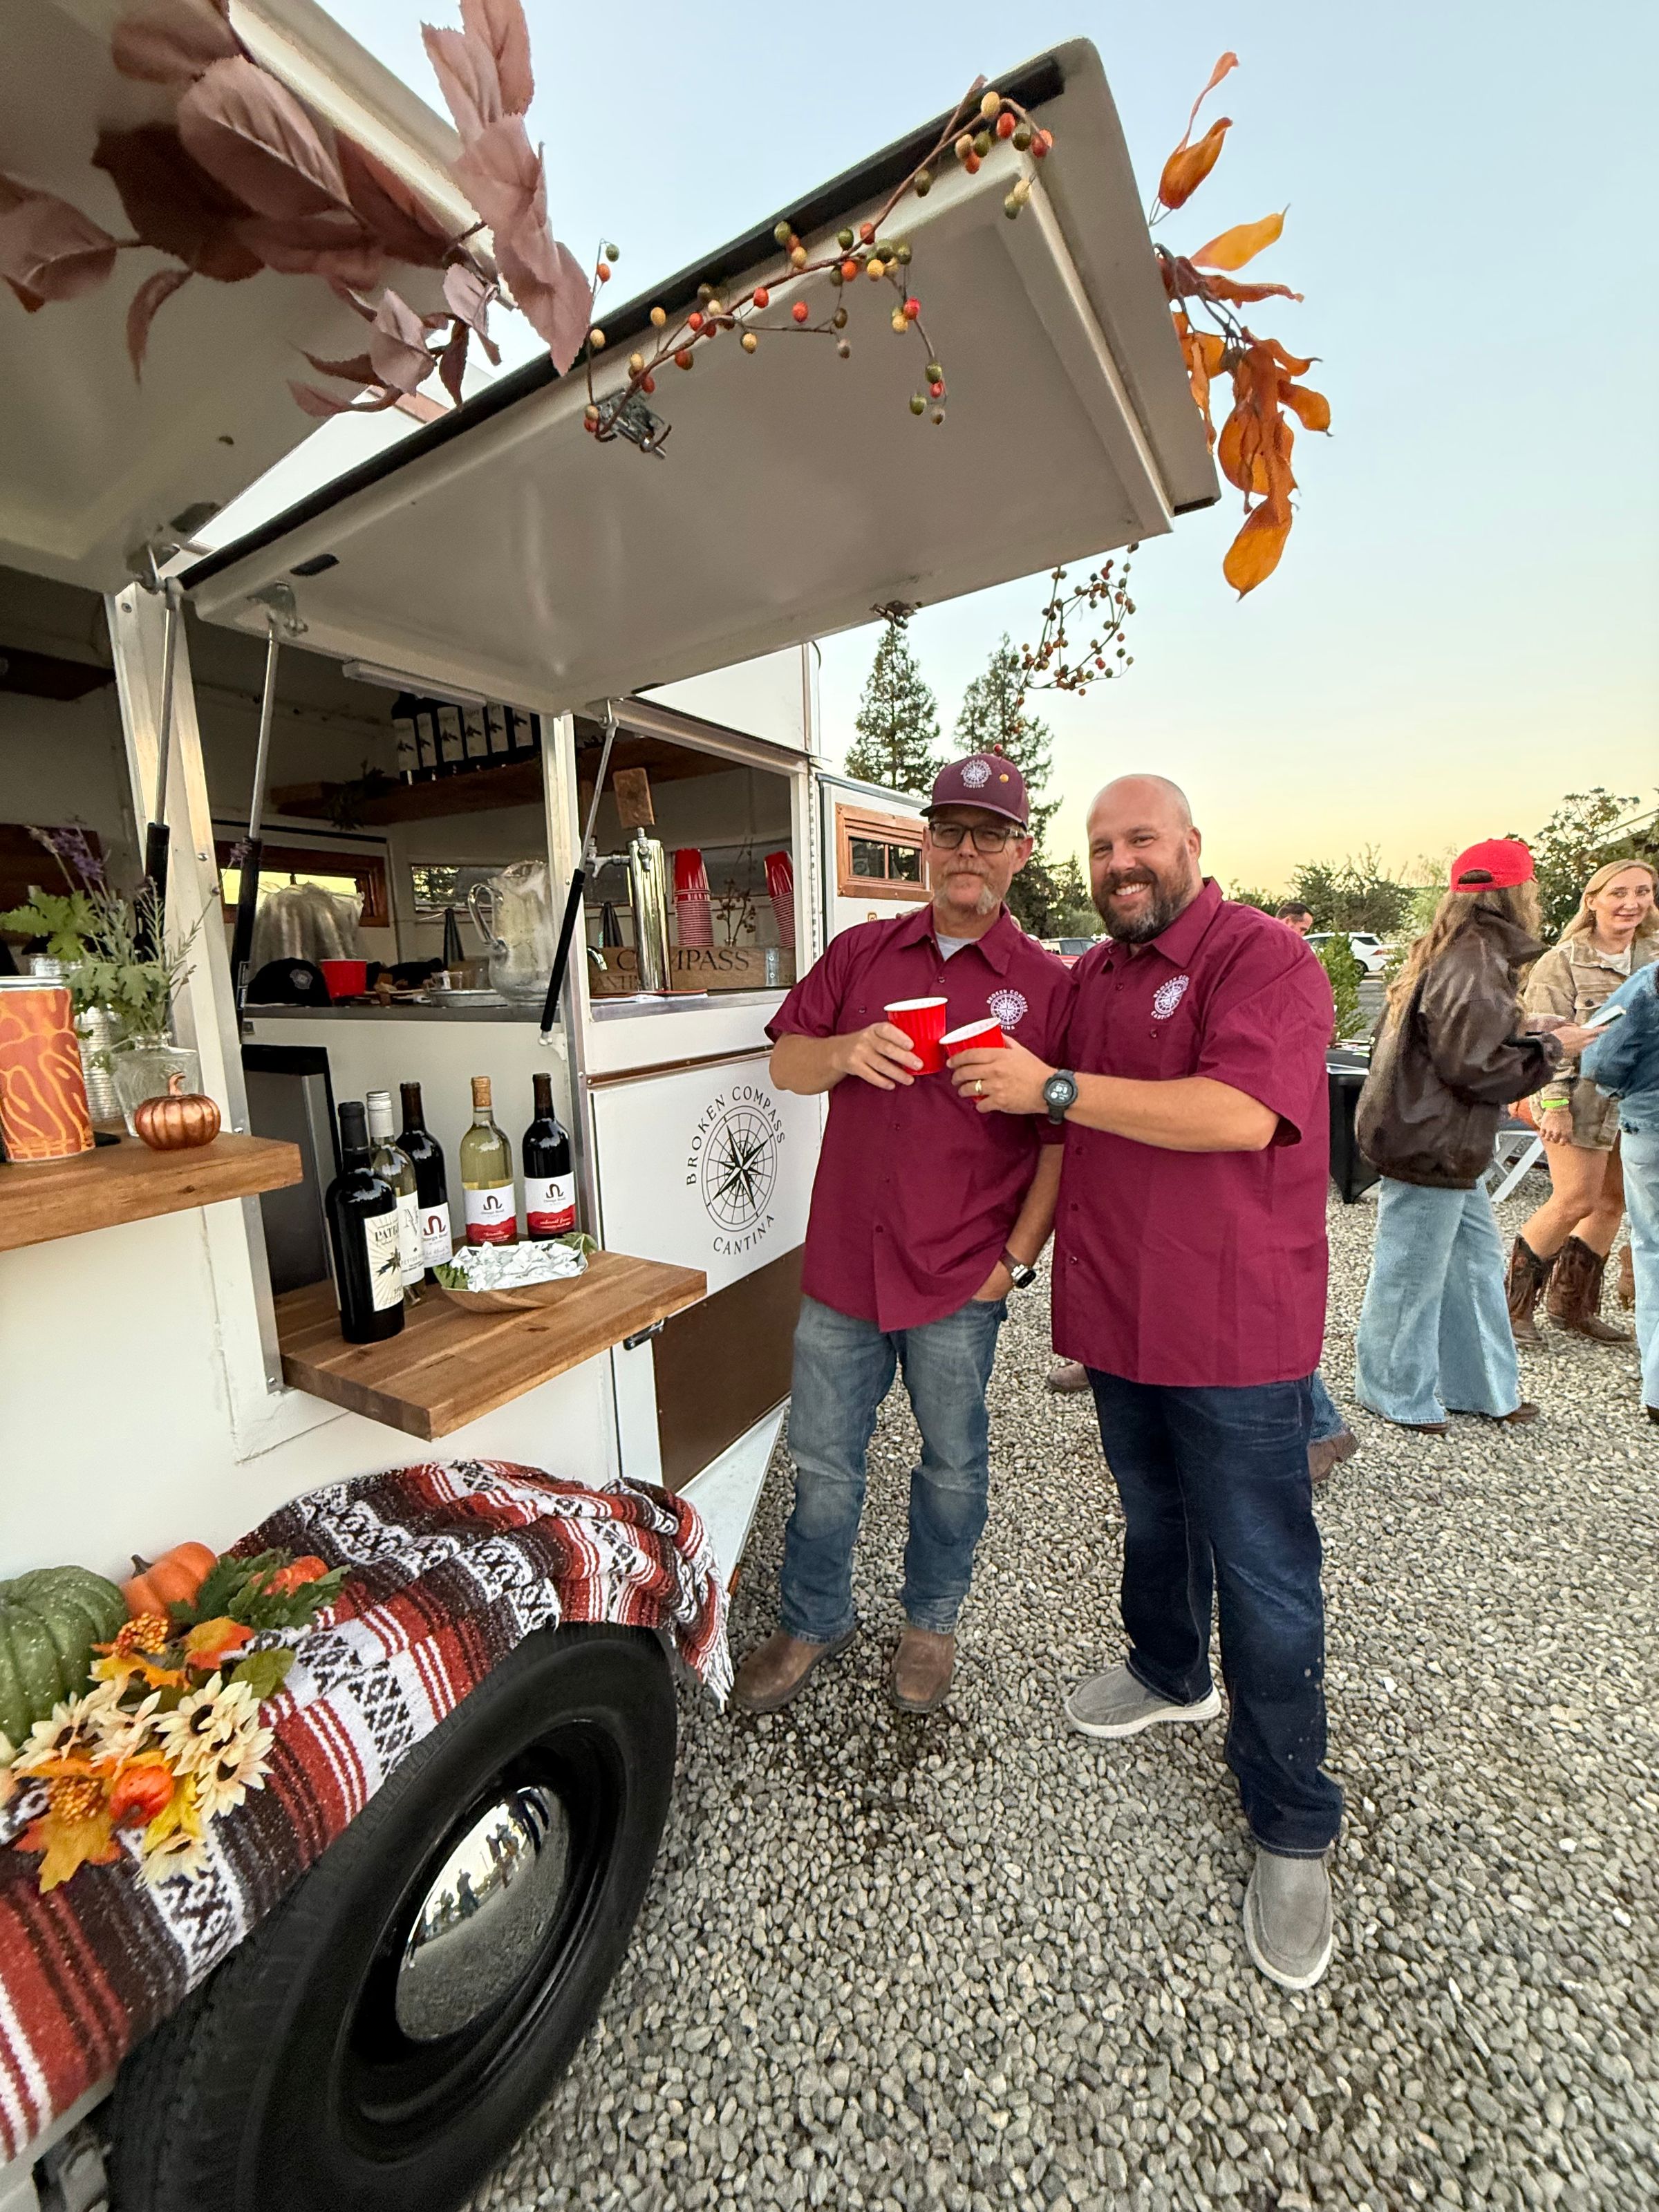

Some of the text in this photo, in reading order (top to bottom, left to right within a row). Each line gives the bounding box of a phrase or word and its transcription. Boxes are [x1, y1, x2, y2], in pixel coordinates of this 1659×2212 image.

[686, 1086, 785, 1185] BROKEN COMPASS
[713, 1213, 774, 1255] CANTINA
